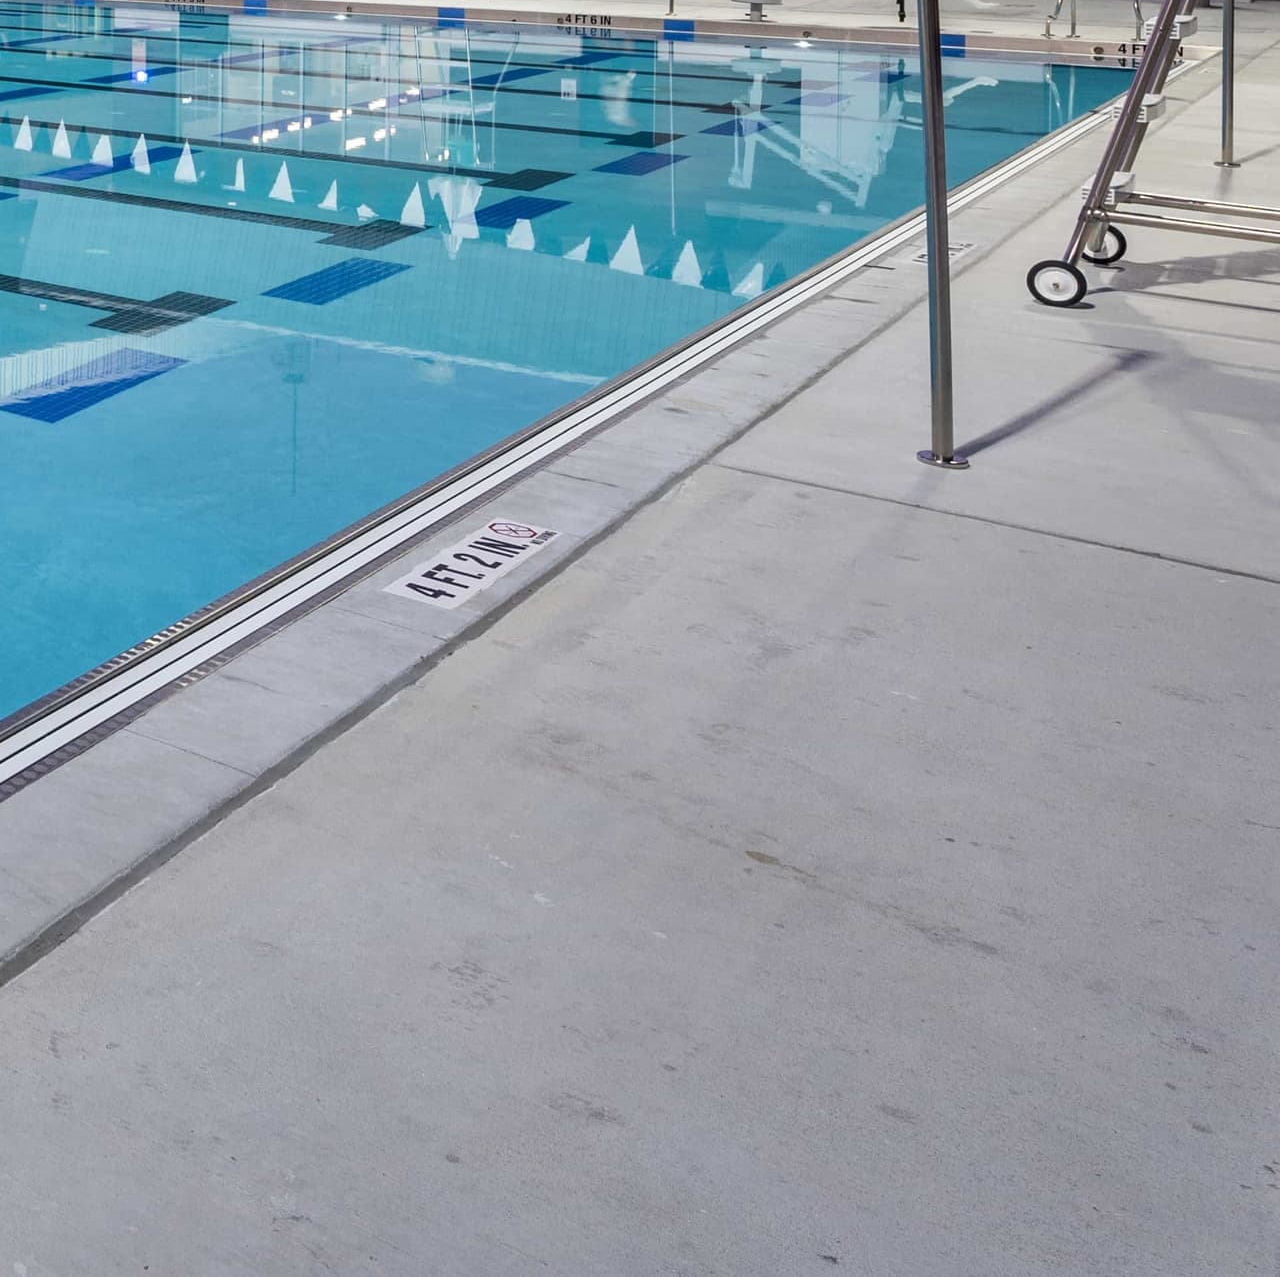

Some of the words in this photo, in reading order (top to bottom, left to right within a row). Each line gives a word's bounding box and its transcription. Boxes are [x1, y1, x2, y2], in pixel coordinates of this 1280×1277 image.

[565, 14, 571, 24] 4
[575, 14, 587, 24] FT
[590, 15, 597, 25] 6
[600, 16, 611, 26] IN
[1118, 43, 1127, 54] 4
[405, 582, 457, 599] 4
[452, 552, 504, 569] 2
